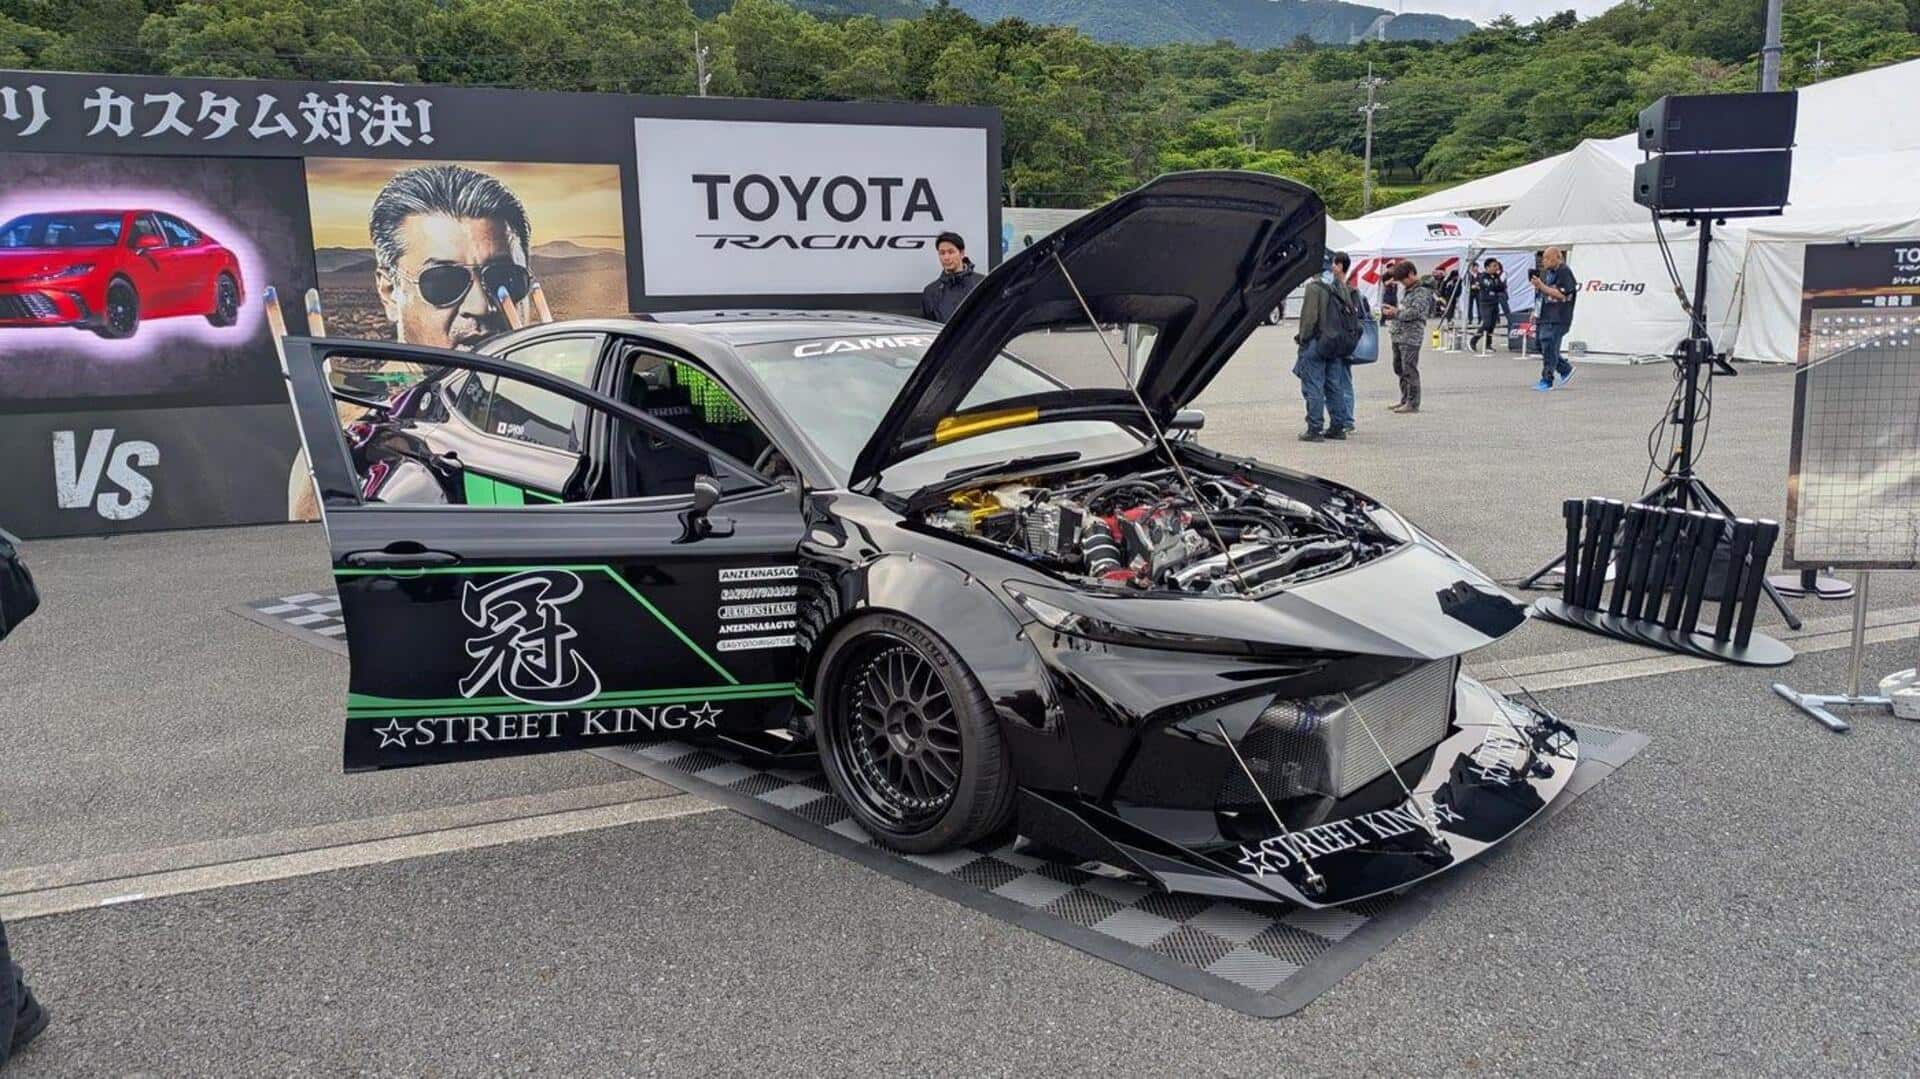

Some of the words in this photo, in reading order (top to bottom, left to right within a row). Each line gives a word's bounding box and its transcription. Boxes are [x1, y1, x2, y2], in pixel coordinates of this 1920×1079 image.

[83, 86, 433, 147] カスタム対決!
[691, 173, 944, 223] TOYOTA
[695, 233, 938, 250] RACING
[1586, 280, 1646, 296] Racing
[52, 428, 160, 521] VS
[459, 567, 601, 706] 冠
[414, 711, 569, 746] STREET
[580, 702, 689, 736] KING
[1259, 818, 1371, 868] STREET
